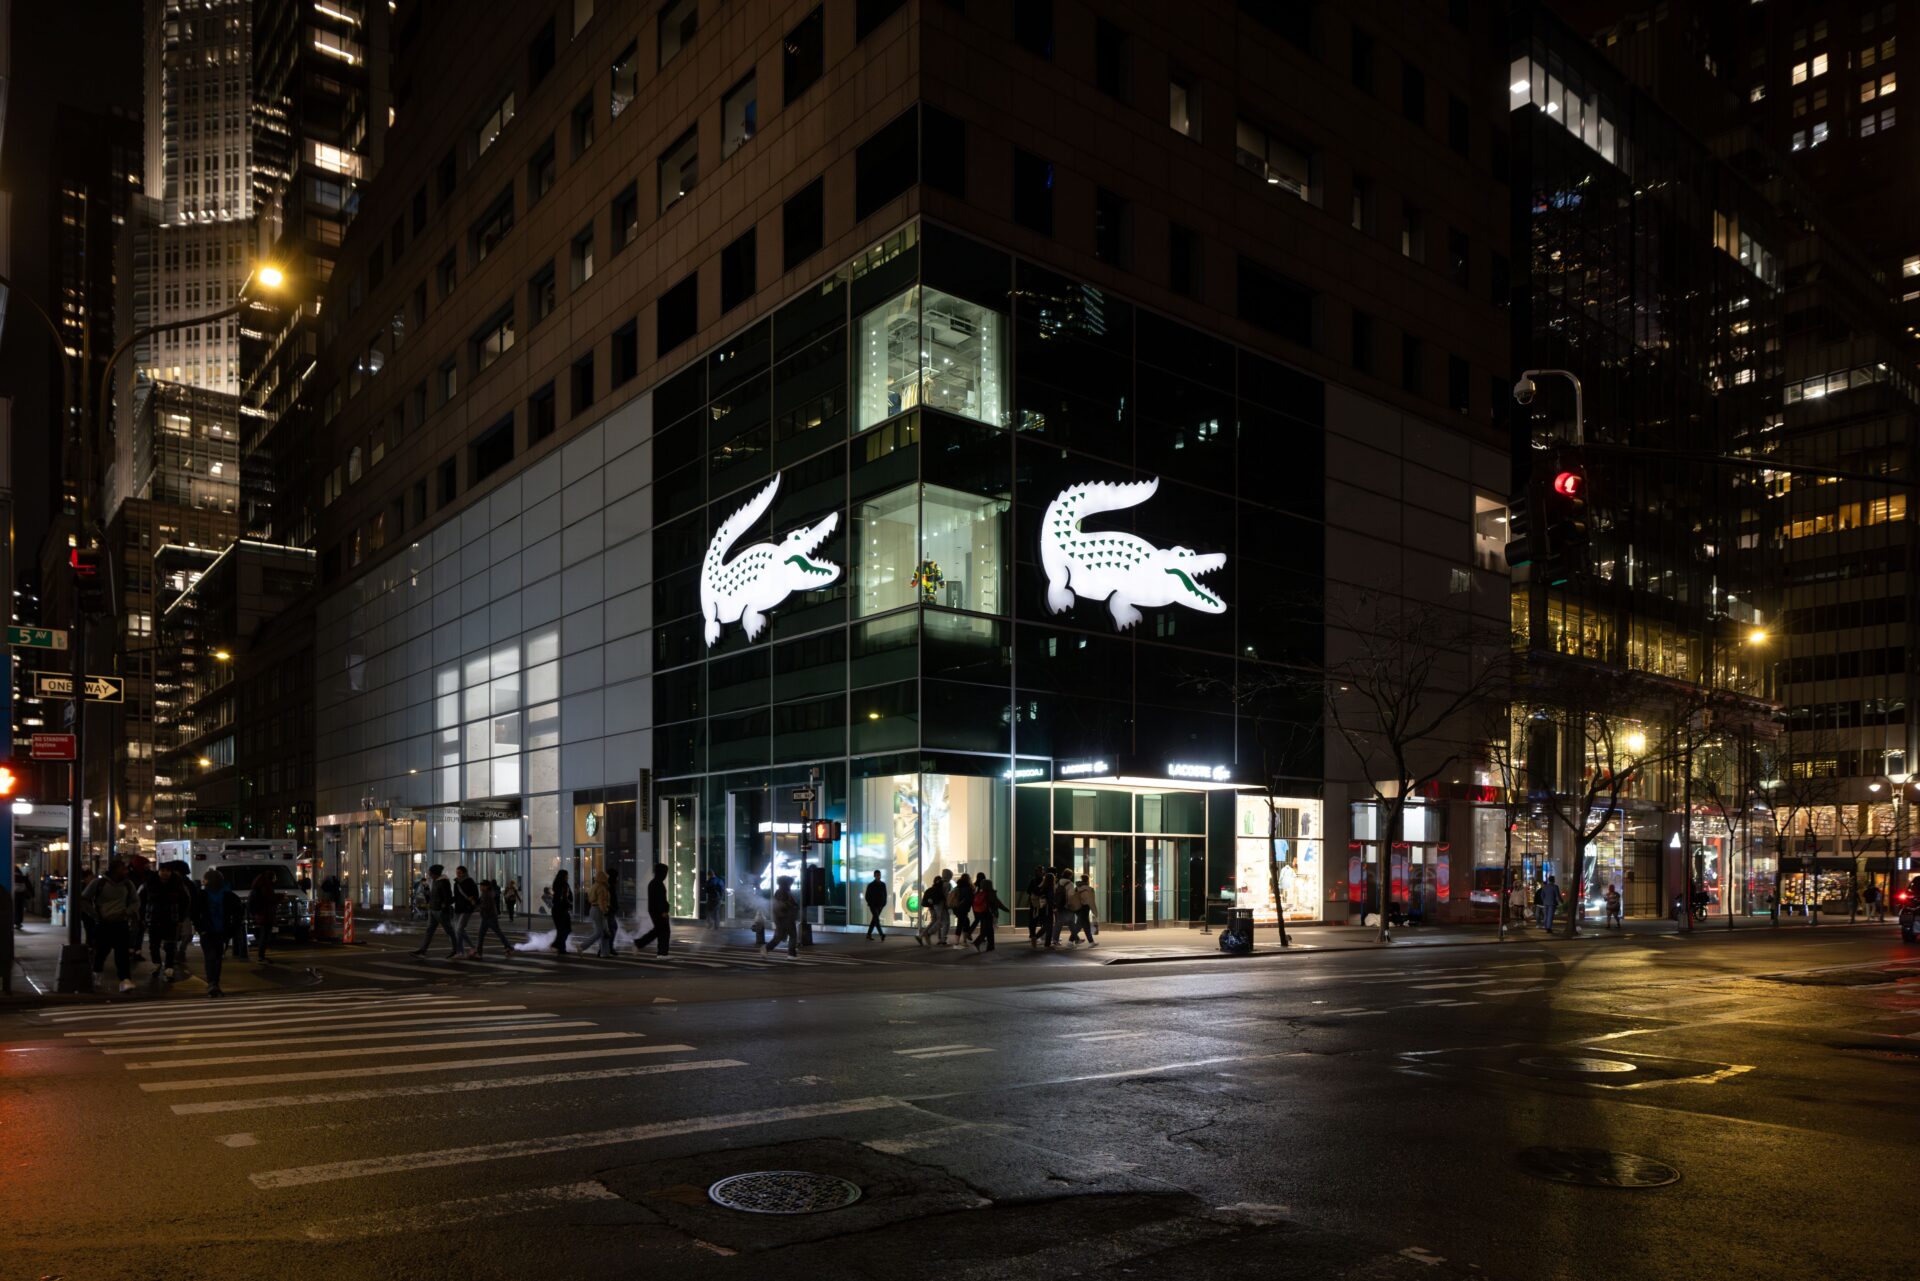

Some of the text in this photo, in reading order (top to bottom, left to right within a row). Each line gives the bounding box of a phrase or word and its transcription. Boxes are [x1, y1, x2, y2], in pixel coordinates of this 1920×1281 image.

[19, 629, 47, 643] 5 AV
[48, 680, 110, 694] ONE WAY
[1168, 764, 1211, 778] LACOSTE
[484, 810, 508, 819] SPACE
